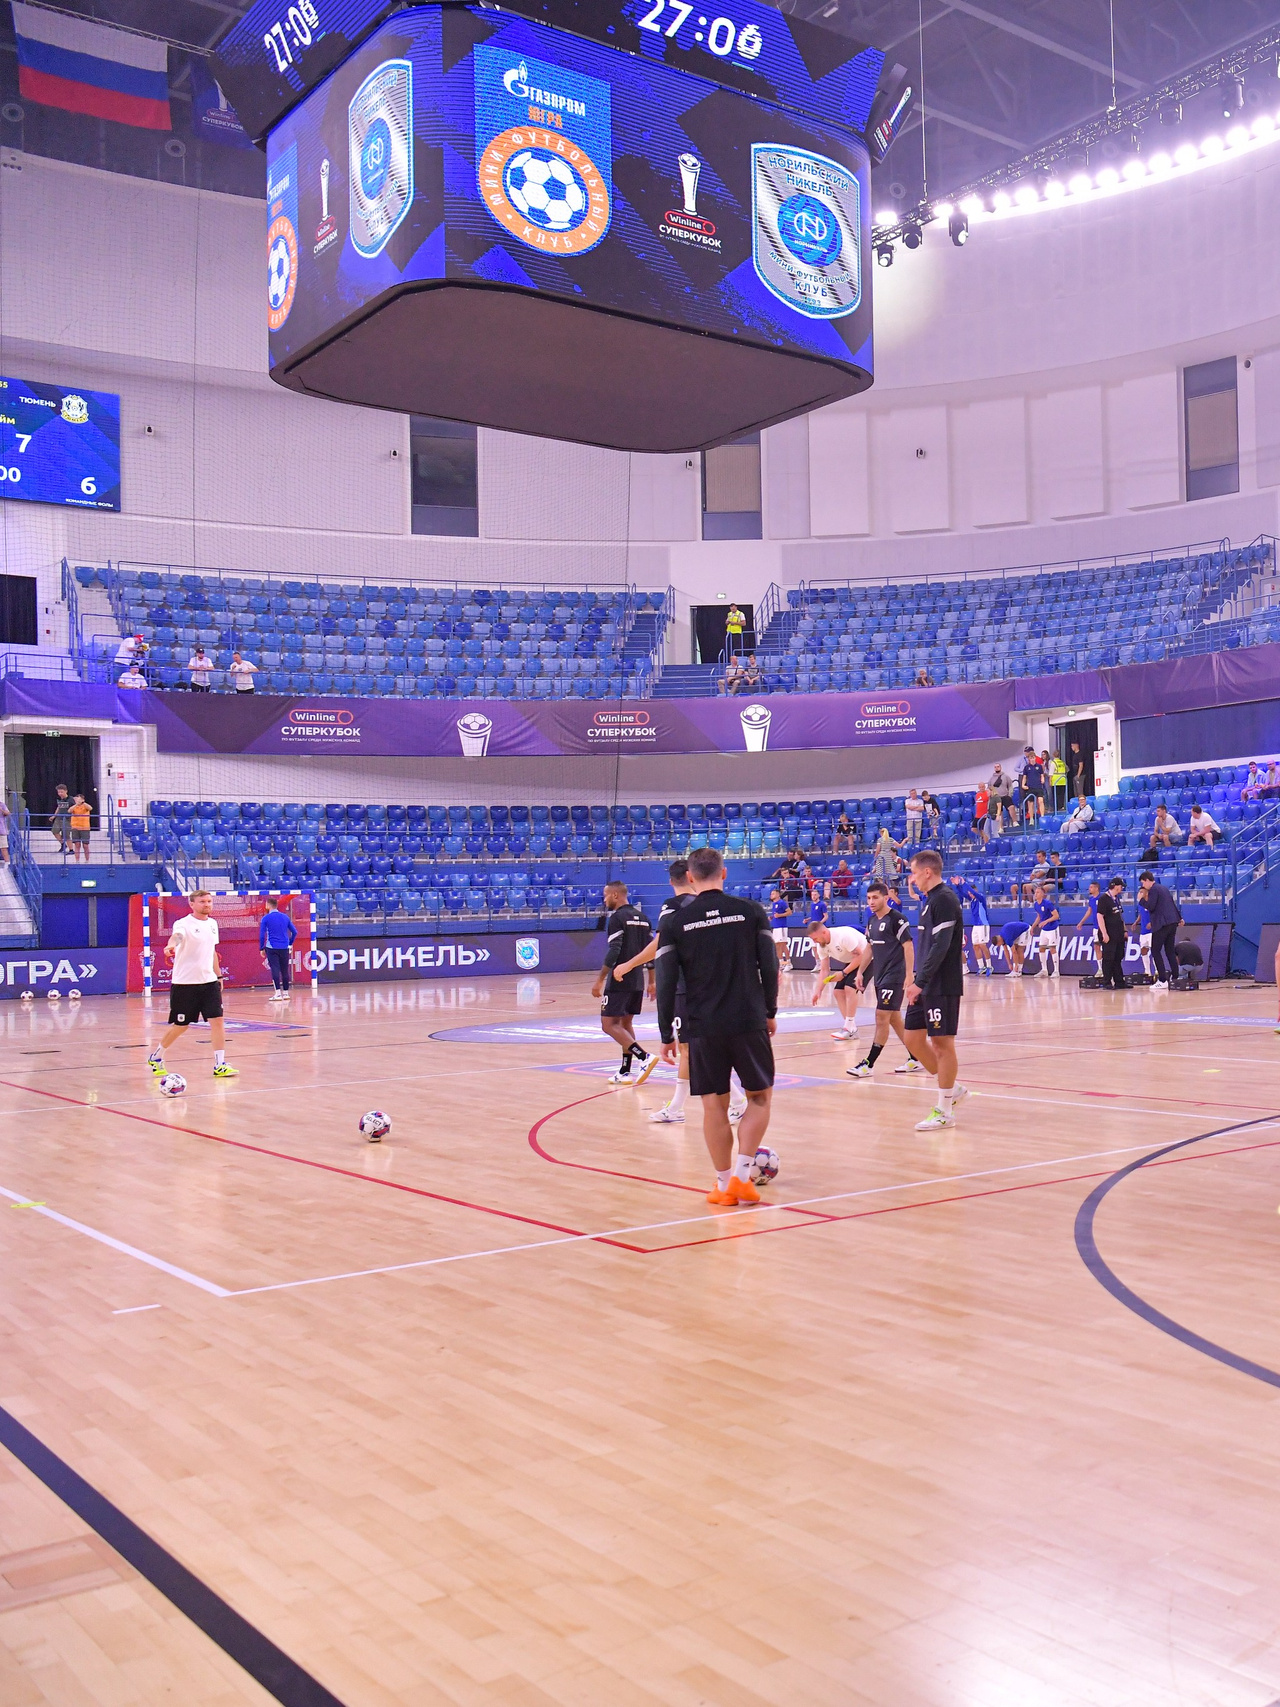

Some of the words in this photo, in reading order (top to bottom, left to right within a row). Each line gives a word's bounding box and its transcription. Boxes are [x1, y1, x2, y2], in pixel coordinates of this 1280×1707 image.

[528, 85, 586, 117] ГАЗПРОМ
[528, 105, 564, 129] ЮГРА
[485, 131, 604, 234] МИНИ-ФУТБОЛЬНЫЙ
[768, 156, 850, 196] НОРИЛЬСКИЙ
[786, 173, 834, 198] НИКЕЛЬ
[669, 213, 702, 230] Winline
[523, 226, 573, 249] КЛУБ
[659, 224, 722, 249] СУПЕРКУБОК
[795, 280, 828, 298] КЛУБ
[19, 396, 56, 408] ТЮМЕНЬ
[15, 433, 32, 453] 7
[80, 477, 97, 495] 6
[295, 712, 336, 722] Winline
[866, 705, 897, 713] Winline
[599, 714, 634, 722] Winline
[855, 717, 917, 728] СУПЕРКУБОК
[281, 726, 361, 737] СУПЕРКУБОК
[587, 727, 657, 737] СУПЕРКУБОК
[683, 917, 722, 931] НОРИЛЬСКИЙ
[722, 914, 746, 924] НИКЕЛЬ
[881, 989, 894, 1000] 77
[927, 1008, 942, 1022] 16
[365, 1115, 382, 1127] SELECT
